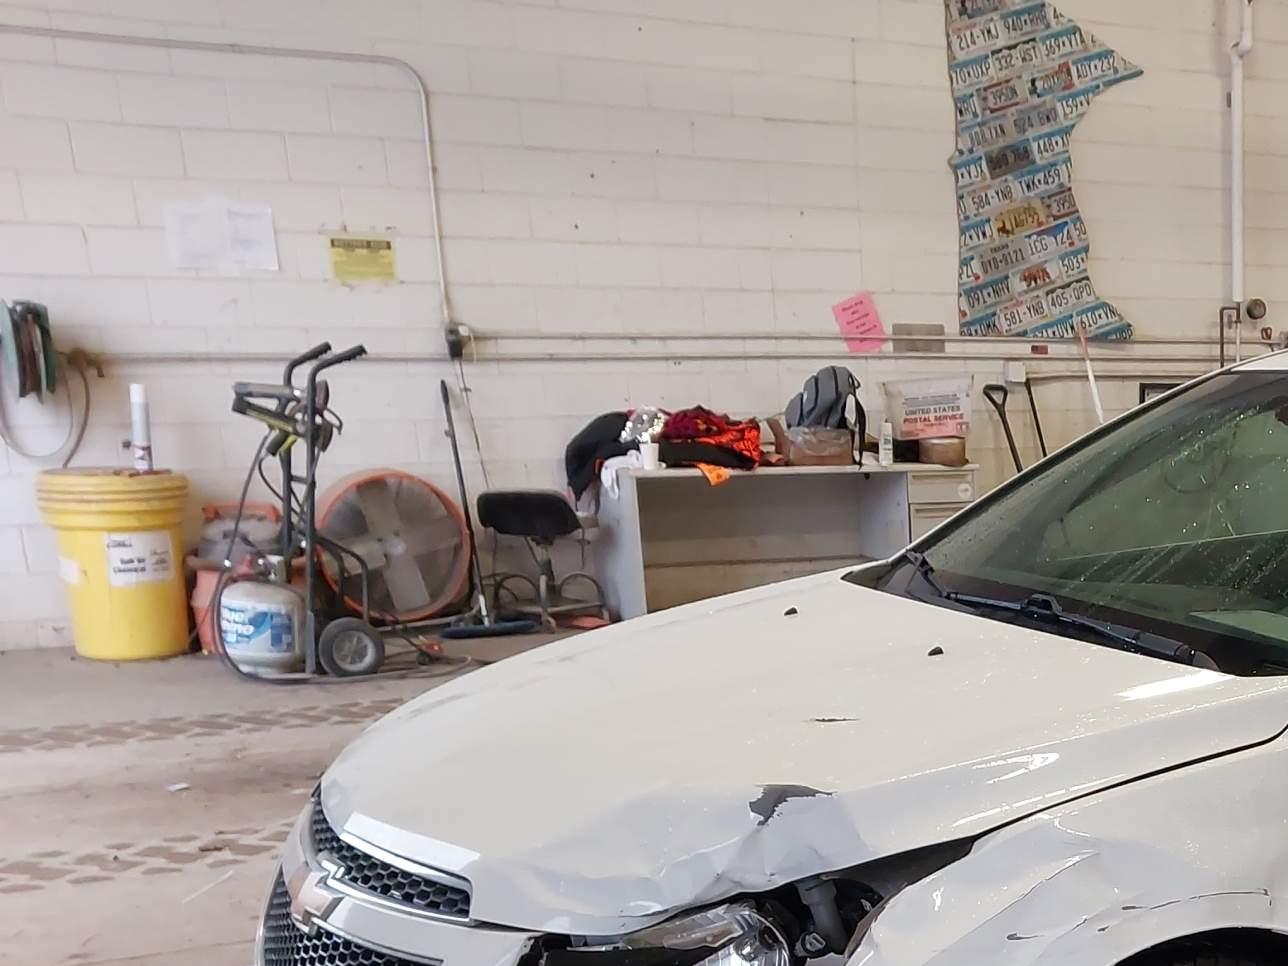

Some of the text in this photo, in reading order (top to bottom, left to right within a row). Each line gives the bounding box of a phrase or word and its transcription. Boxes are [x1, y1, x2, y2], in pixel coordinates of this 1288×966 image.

[933, 405, 960, 413] STATES
[904, 413, 964, 424] POSTAL SERVICE
